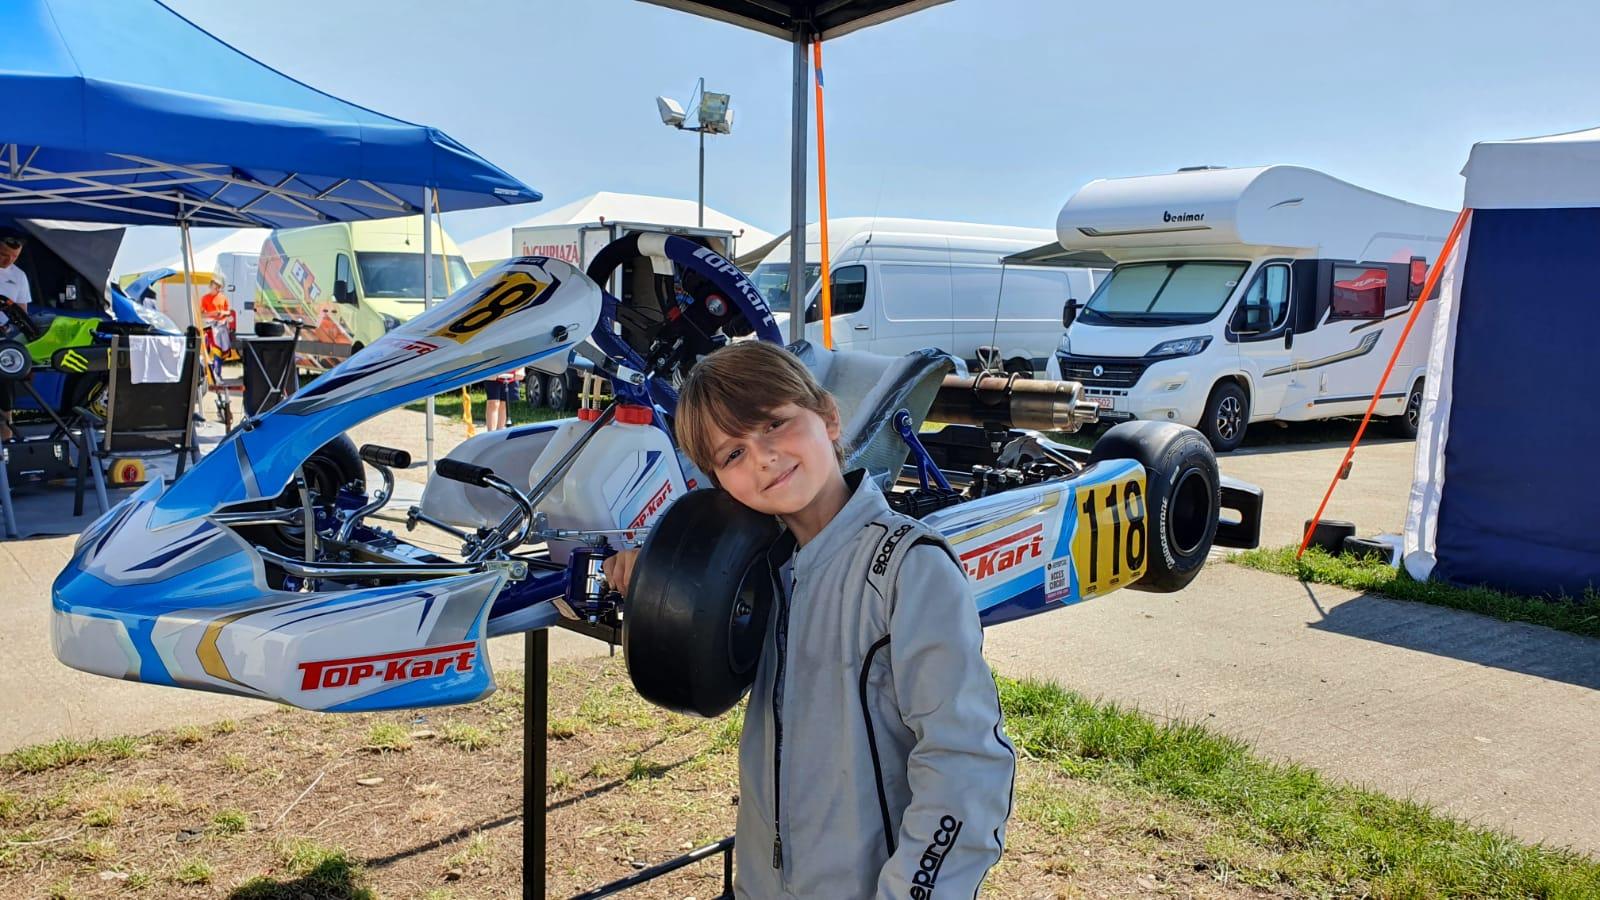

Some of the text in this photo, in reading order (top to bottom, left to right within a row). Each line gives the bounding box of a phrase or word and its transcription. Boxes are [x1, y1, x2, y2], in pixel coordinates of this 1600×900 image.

[1163, 210, 1205, 223] benimar
[872, 524, 914, 576] sparco
[1082, 480, 1146, 583] 118
[910, 815, 963, 900] sparco
